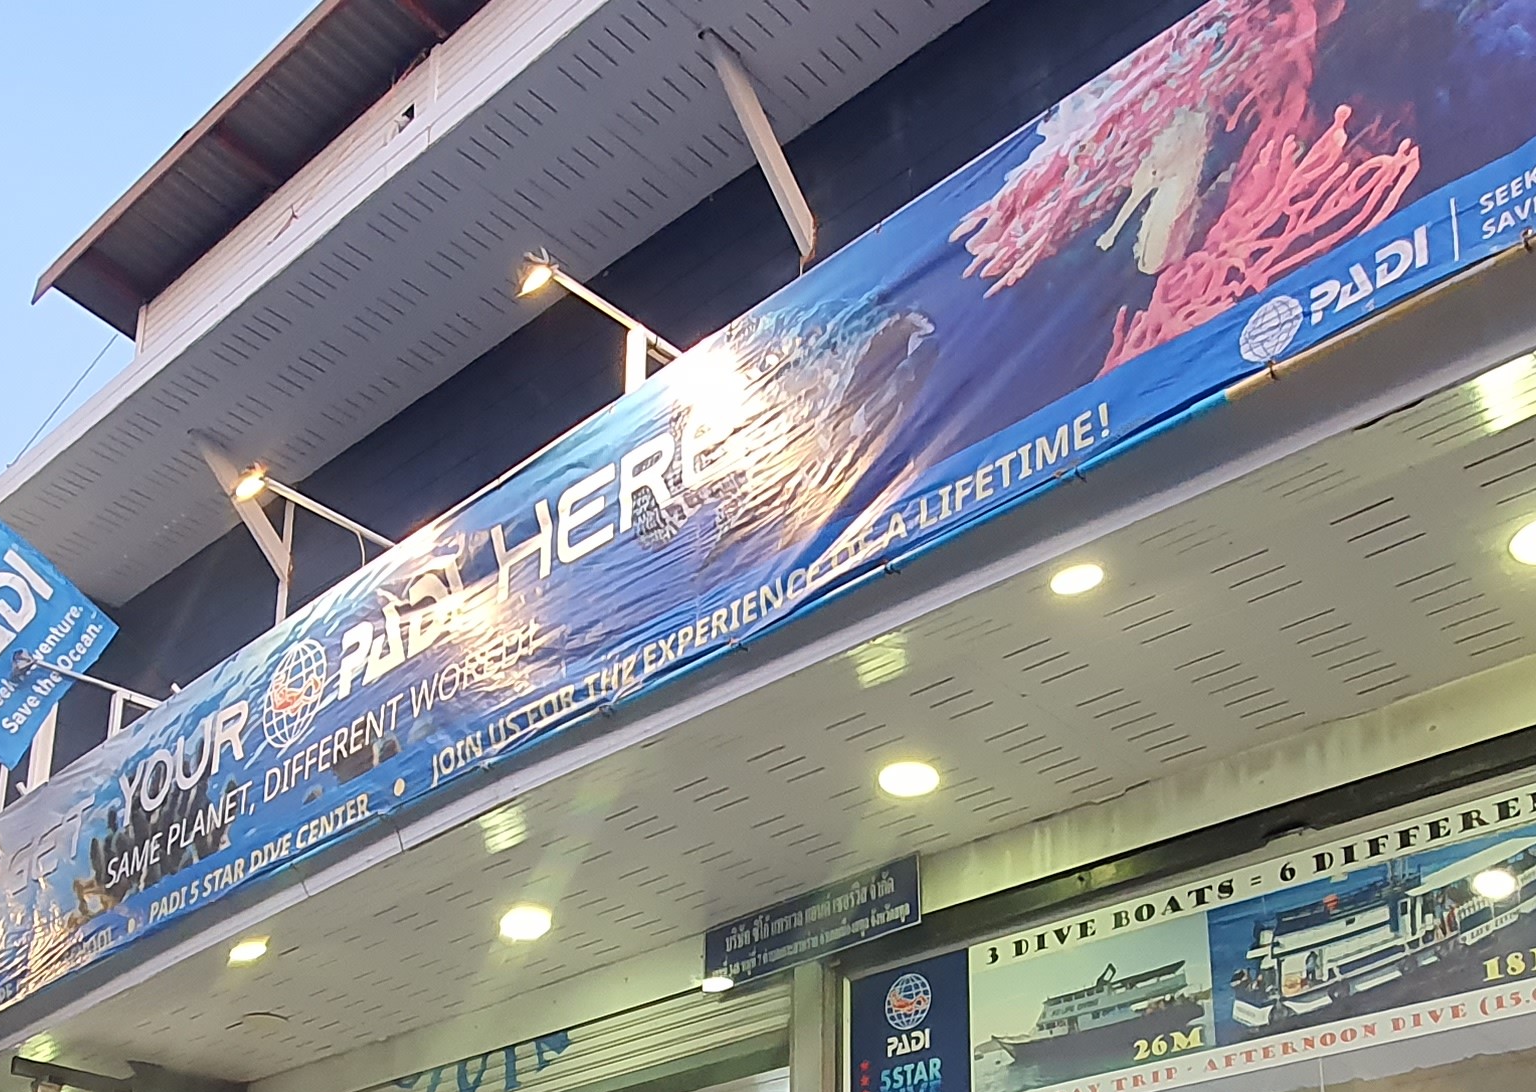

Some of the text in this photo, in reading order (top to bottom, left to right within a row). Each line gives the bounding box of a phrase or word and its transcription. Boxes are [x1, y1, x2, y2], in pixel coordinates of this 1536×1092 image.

[1309, 225, 1430, 326] PADI
[20, 605, 84, 681] venture.
[430, 729, 484, 788] JOIN
[488, 715, 521, 748] US
[527, 684, 575, 725] FOR
[643, 562, 821, 674] EXPERIENCE
[881, 512, 909, 548] A
[918, 403, 1112, 531] LIFETIME!
[1, 624, 104, 734] Save the Ocean.
[118, 699, 249, 827] YOUR
[338, 556, 465, 700] PADI
[105, 832, 163, 889] SAME
[167, 781, 255, 855] PLANET,
[264, 694, 404, 803] DIFFERENT
[149, 794, 370, 924] PADI 5 STAR DIVE CENTER
[986, 948, 1000, 965] 3
[1012, 919, 1096, 956] DIVE
[1113, 878, 1234, 929] BOATS
[1278, 861, 1297, 882] 6
[887, 1028, 930, 1057] PADI
[1115, 1066, 1177, 1092] TRIP
[1204, 1021, 1378, 1073] AFTERNOON
[1392, 1003, 1468, 1033] DIVE
[1133, 1026, 1205, 1061] 26M
